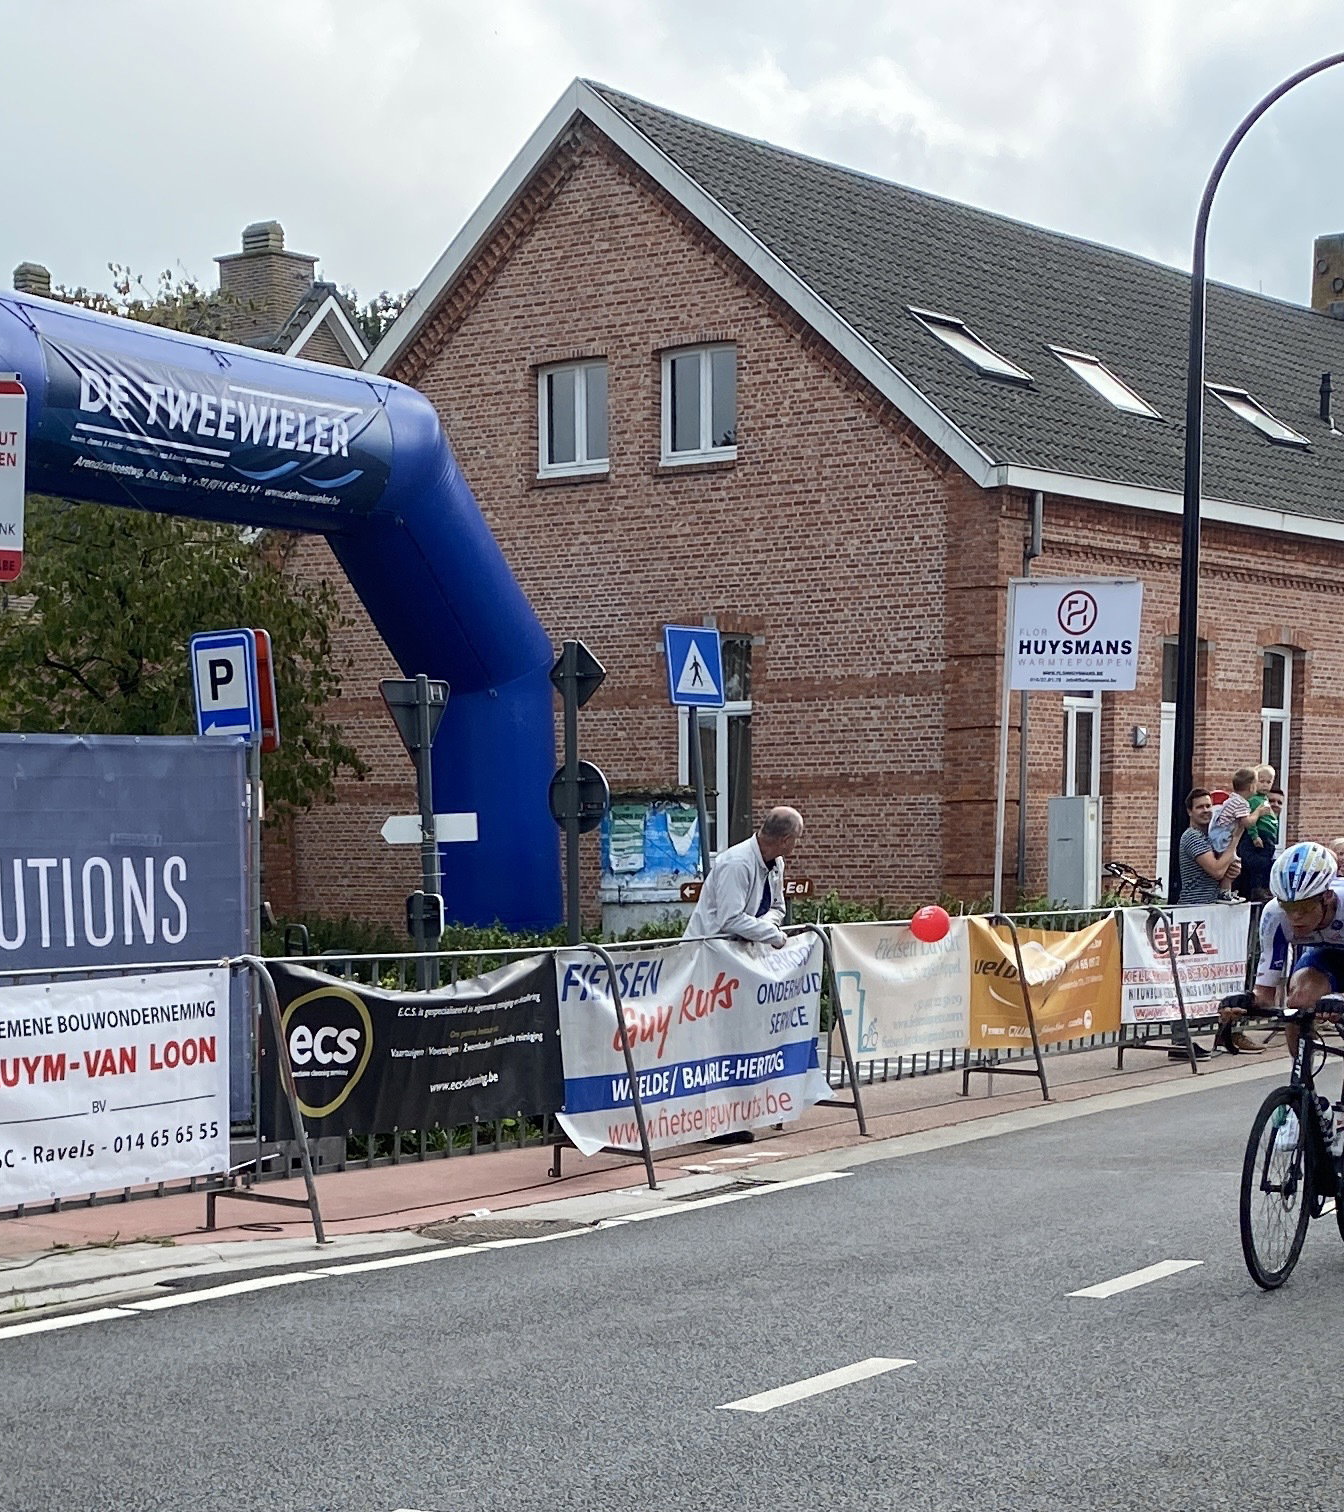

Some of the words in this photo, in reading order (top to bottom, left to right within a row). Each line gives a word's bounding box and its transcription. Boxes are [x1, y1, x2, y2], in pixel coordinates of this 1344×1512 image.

[79, 367, 130, 420] DE
[142, 382, 350, 458] TWEEWIELER
[1018, 639, 1132, 655] HUYSMANS
[1019, 628, 1048, 637] FLOR
[208, 658, 234, 701] P
[1018, 658, 1132, 667] WARMTEPOMPEN
[757, 972, 821, 1006] ONDERHOUD
[57, 1000, 216, 1034] BOUWONDERNEMING
[613, 1005, 674, 1059] Guy
[679, 972, 740, 1025] Ruts
[769, 1005, 809, 1035] SERVICE
[150, 1036, 217, 1071] LOON
[289, 1024, 361, 1066] ecs
[682, 1051, 785, 1090] BAARLE-HERTOG
[91, 1100, 107, 1115] BV
[33, 1140, 95, 1165] Ravels
[113, 1134, 145, 1154] 014
[150, 1128, 170, 1148] 65
[175, 1123, 194, 1144] 65
[199, 1121, 219, 1140] 55
